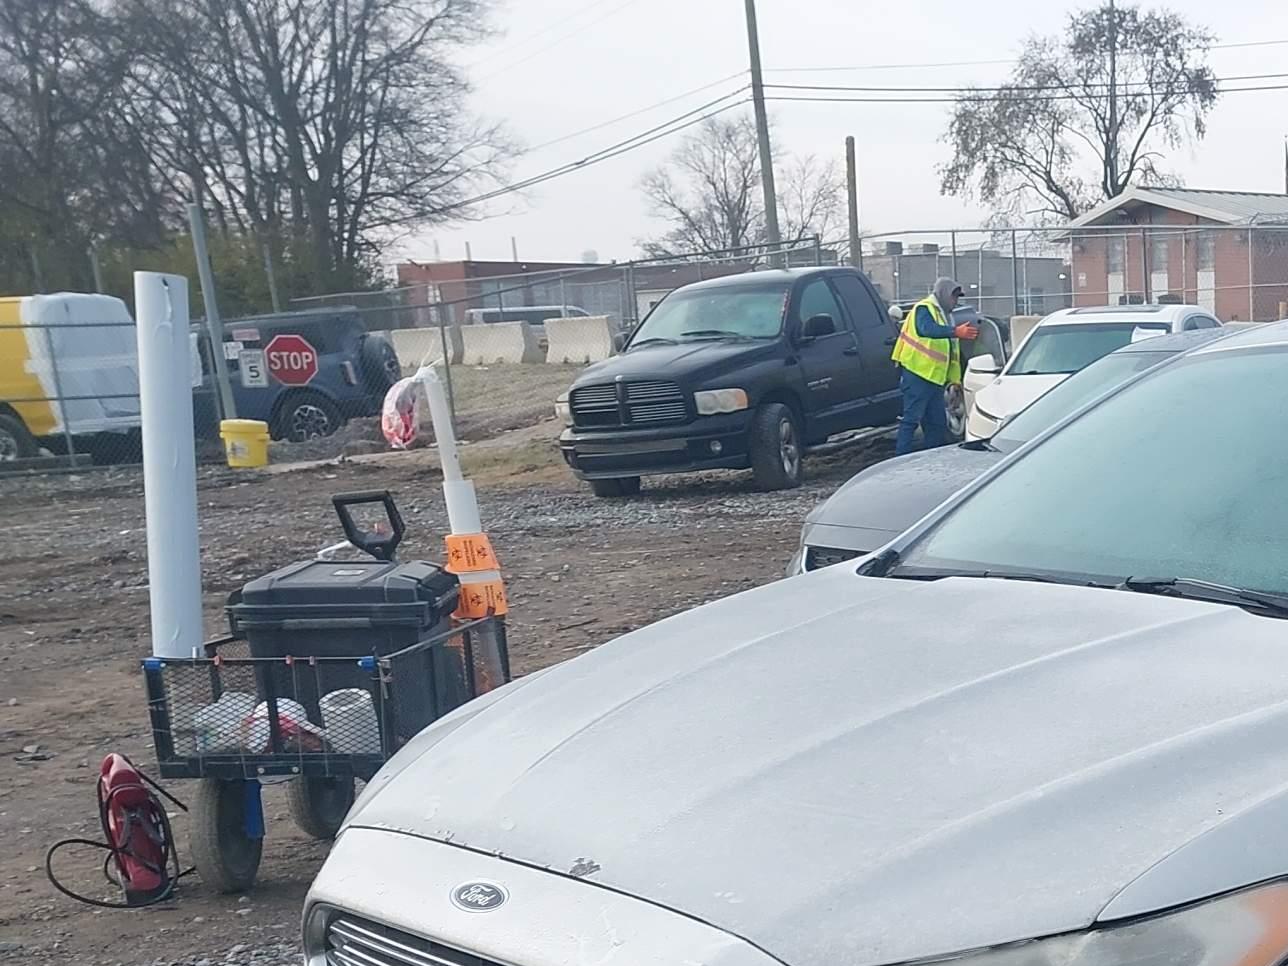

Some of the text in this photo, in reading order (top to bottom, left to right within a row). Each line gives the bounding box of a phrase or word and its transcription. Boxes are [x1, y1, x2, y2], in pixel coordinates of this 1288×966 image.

[270, 351, 313, 370] STOP
[249, 365, 260, 378] 5
[460, 884, 497, 906] Ford
